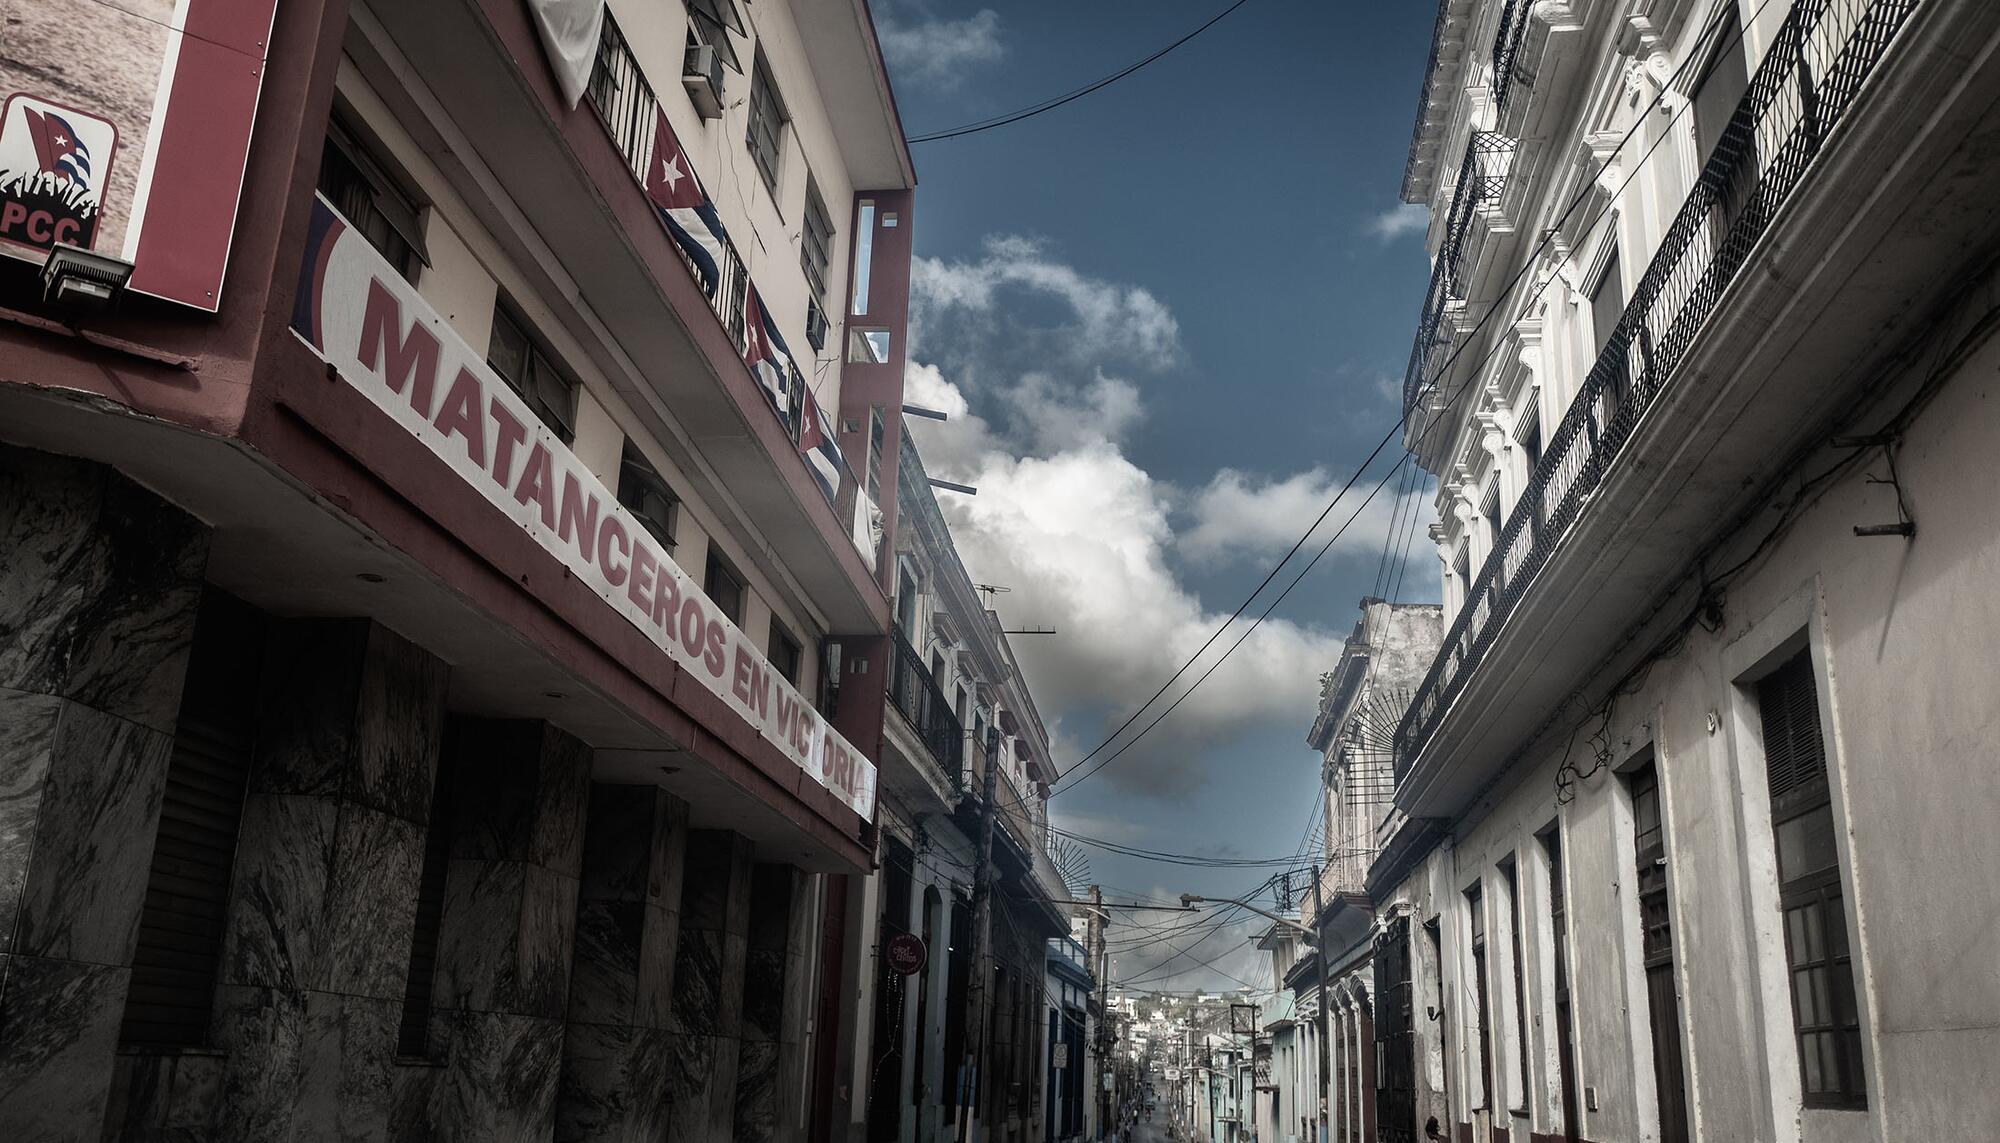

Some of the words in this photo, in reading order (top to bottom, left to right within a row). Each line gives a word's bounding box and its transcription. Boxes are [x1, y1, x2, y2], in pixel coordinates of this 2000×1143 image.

[0, 200, 80, 246] PCC
[357, 275, 727, 679] MATANCEROS
[732, 644, 770, 720] EN
[776, 683, 868, 803] VICORIA
